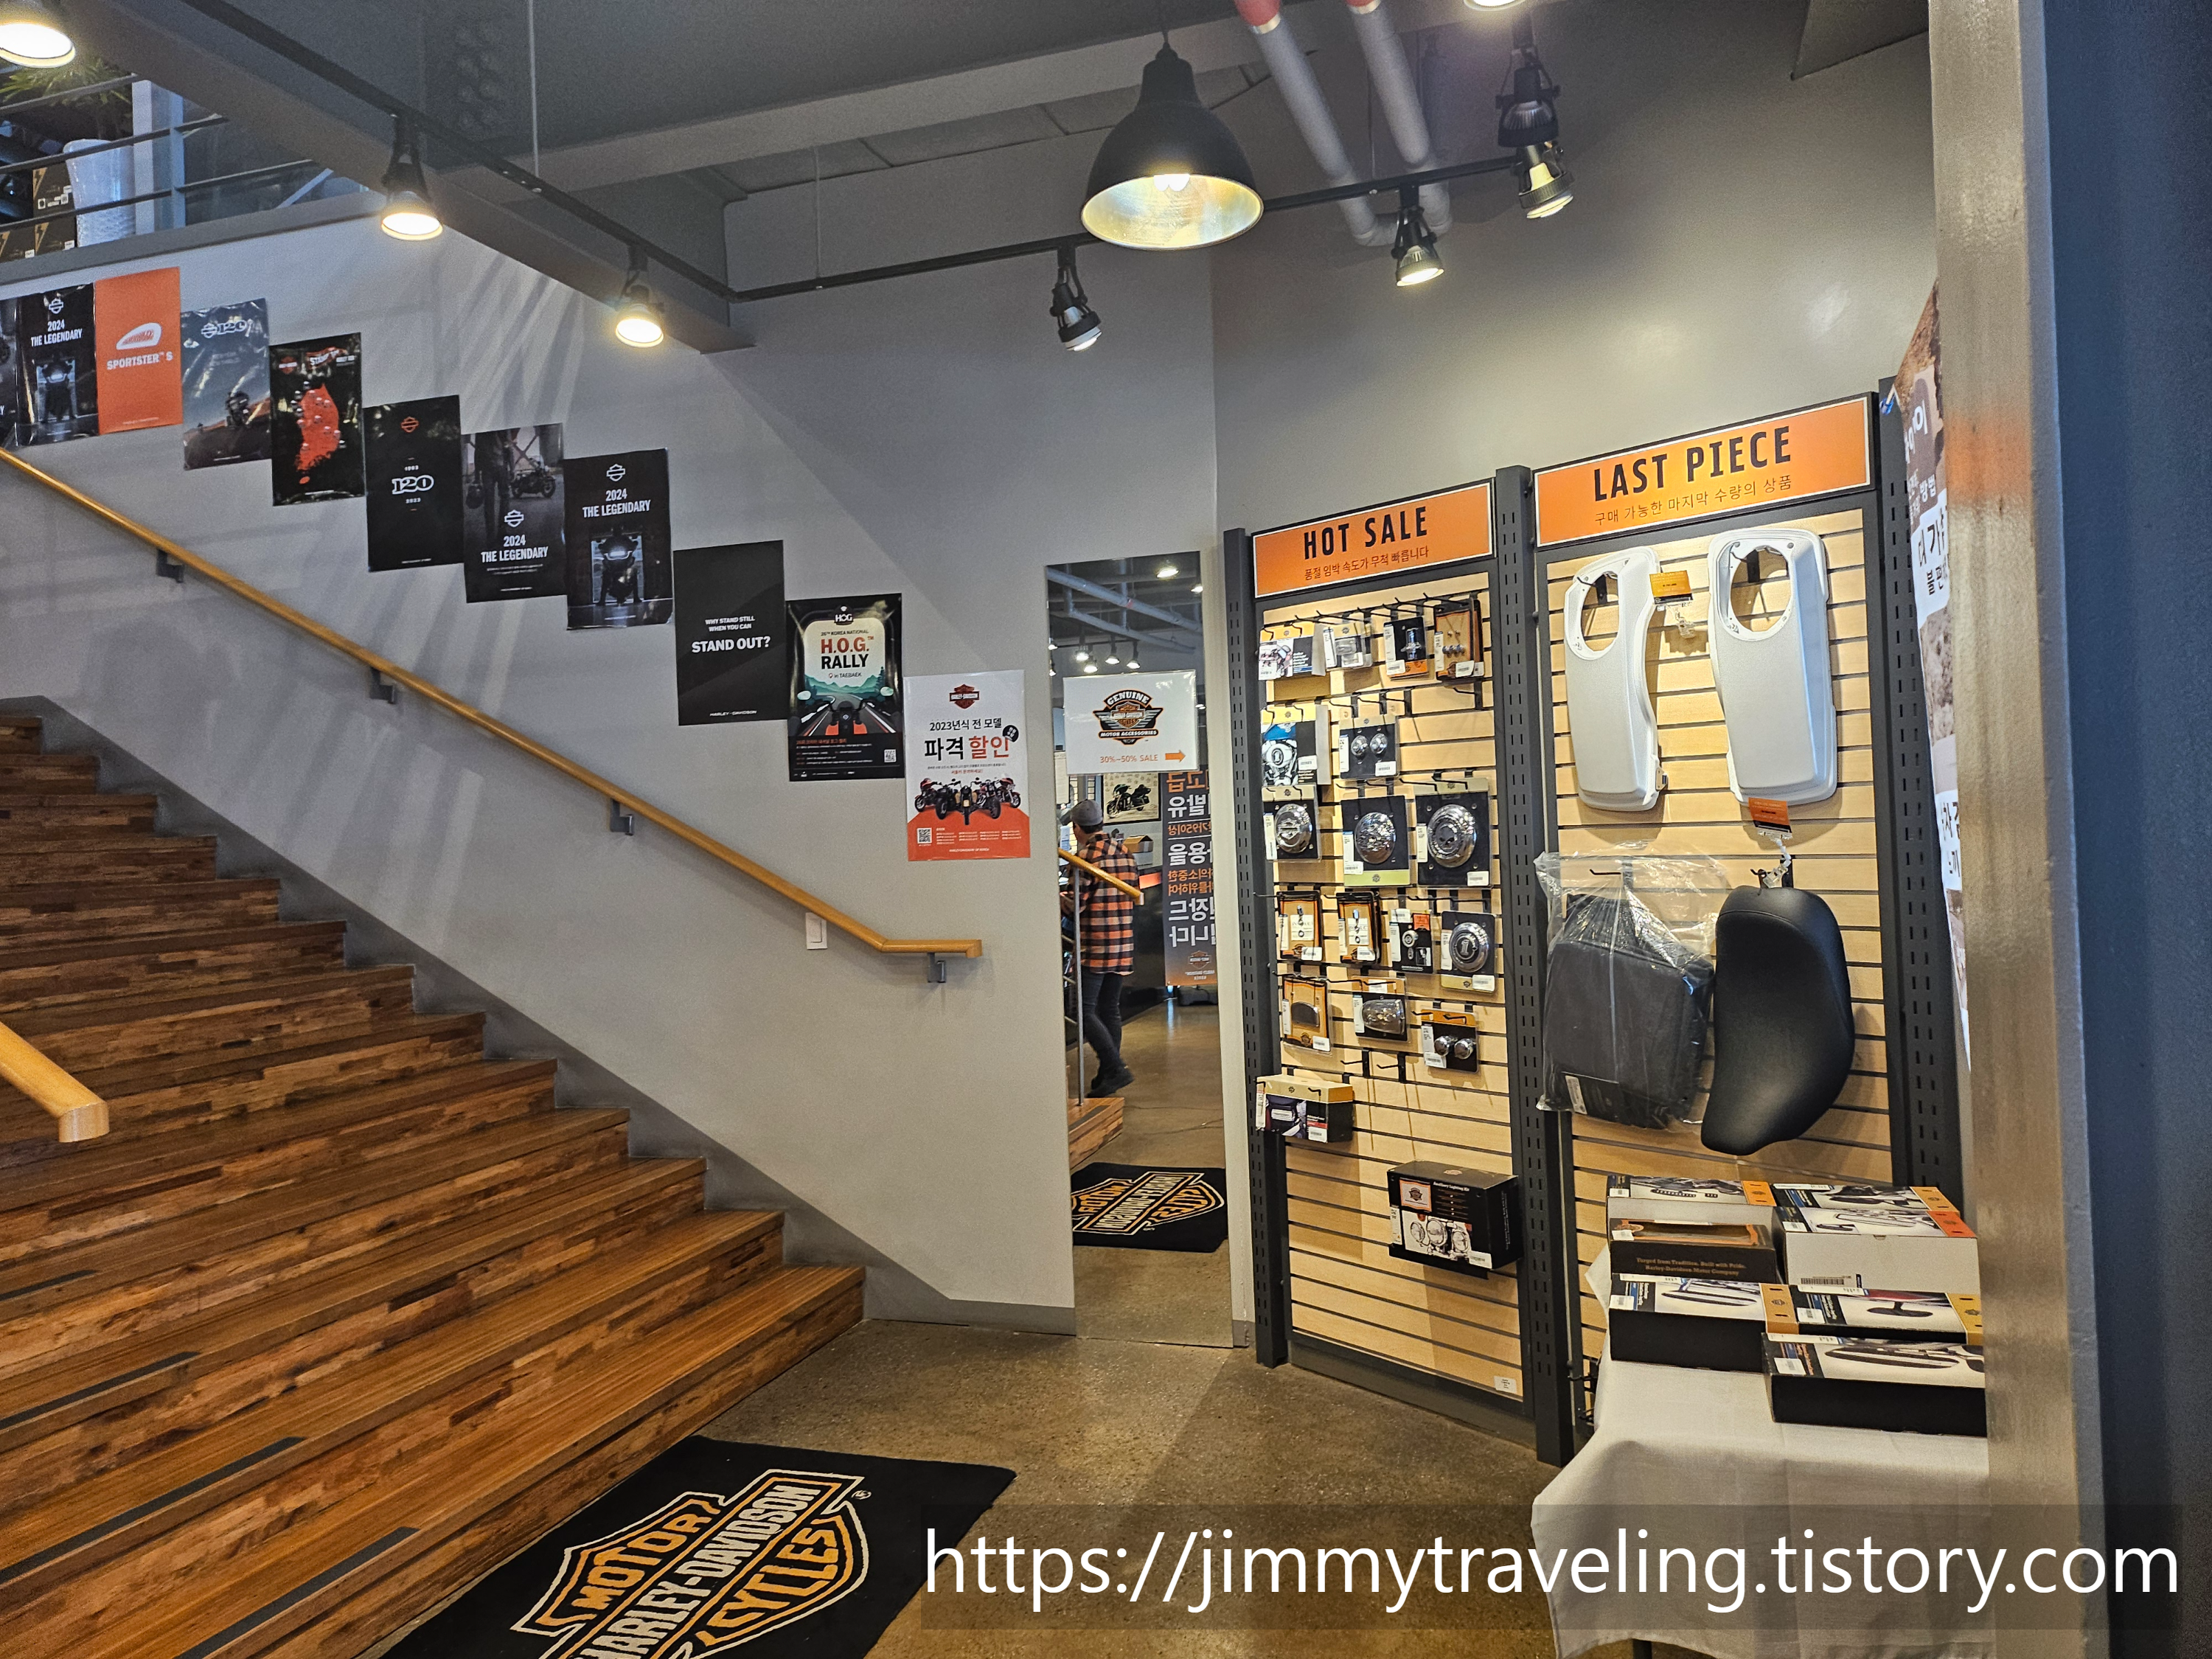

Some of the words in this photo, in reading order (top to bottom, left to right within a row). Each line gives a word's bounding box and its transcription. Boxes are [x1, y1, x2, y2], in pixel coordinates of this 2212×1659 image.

[47, 319, 65, 332] 2024
[30, 335, 43, 347] THE
[44, 328, 83, 345] LEGENDARY
[165, 351, 174, 361] S
[1594, 453, 1668, 501] LAST
[1687, 426, 1791, 482] PIECE
[392, 475, 434, 494] 120
[606, 488, 627, 501] 2024
[1594, 510, 1618, 526] 구매
[1624, 501, 1663, 519] 가능한
[1668, 491, 1708, 510] 마지막
[1714, 481, 1756, 500] 수량의
[1764, 474, 1792, 493] 상품
[582, 506, 599, 518] THE
[601, 500, 650, 516] LEGENDARY
[503, 535, 526, 547] 2024
[1304, 523, 1349, 560] HOT
[1365, 506, 1427, 547] SALE
[481, 551, 497, 563] THE
[498, 546, 549, 561] LEGENDARY
[1324, 563, 1340, 577] 임박
[1342, 557, 1368, 574] 속도가
[1371, 553, 1389, 568] 무척
[1391, 546, 1429, 563] 빠릅니다
[835, 613, 852, 622] HOG
[692, 639, 734, 653] STAND
[737, 636, 771, 649] OUT?
[821, 653, 869, 669] RALLY
[1107, 692, 1150, 705] GENUINE
[929, 718, 970, 731] 2023년식
[972, 718, 982, 729] 전
[984, 717, 1003, 728] 모델
[925, 737, 964, 761] 파격
[969, 736, 1010, 759] 할인
[571, 1513, 712, 1610] MOTOR
[706, 1527, 840, 1628] CYCLES
